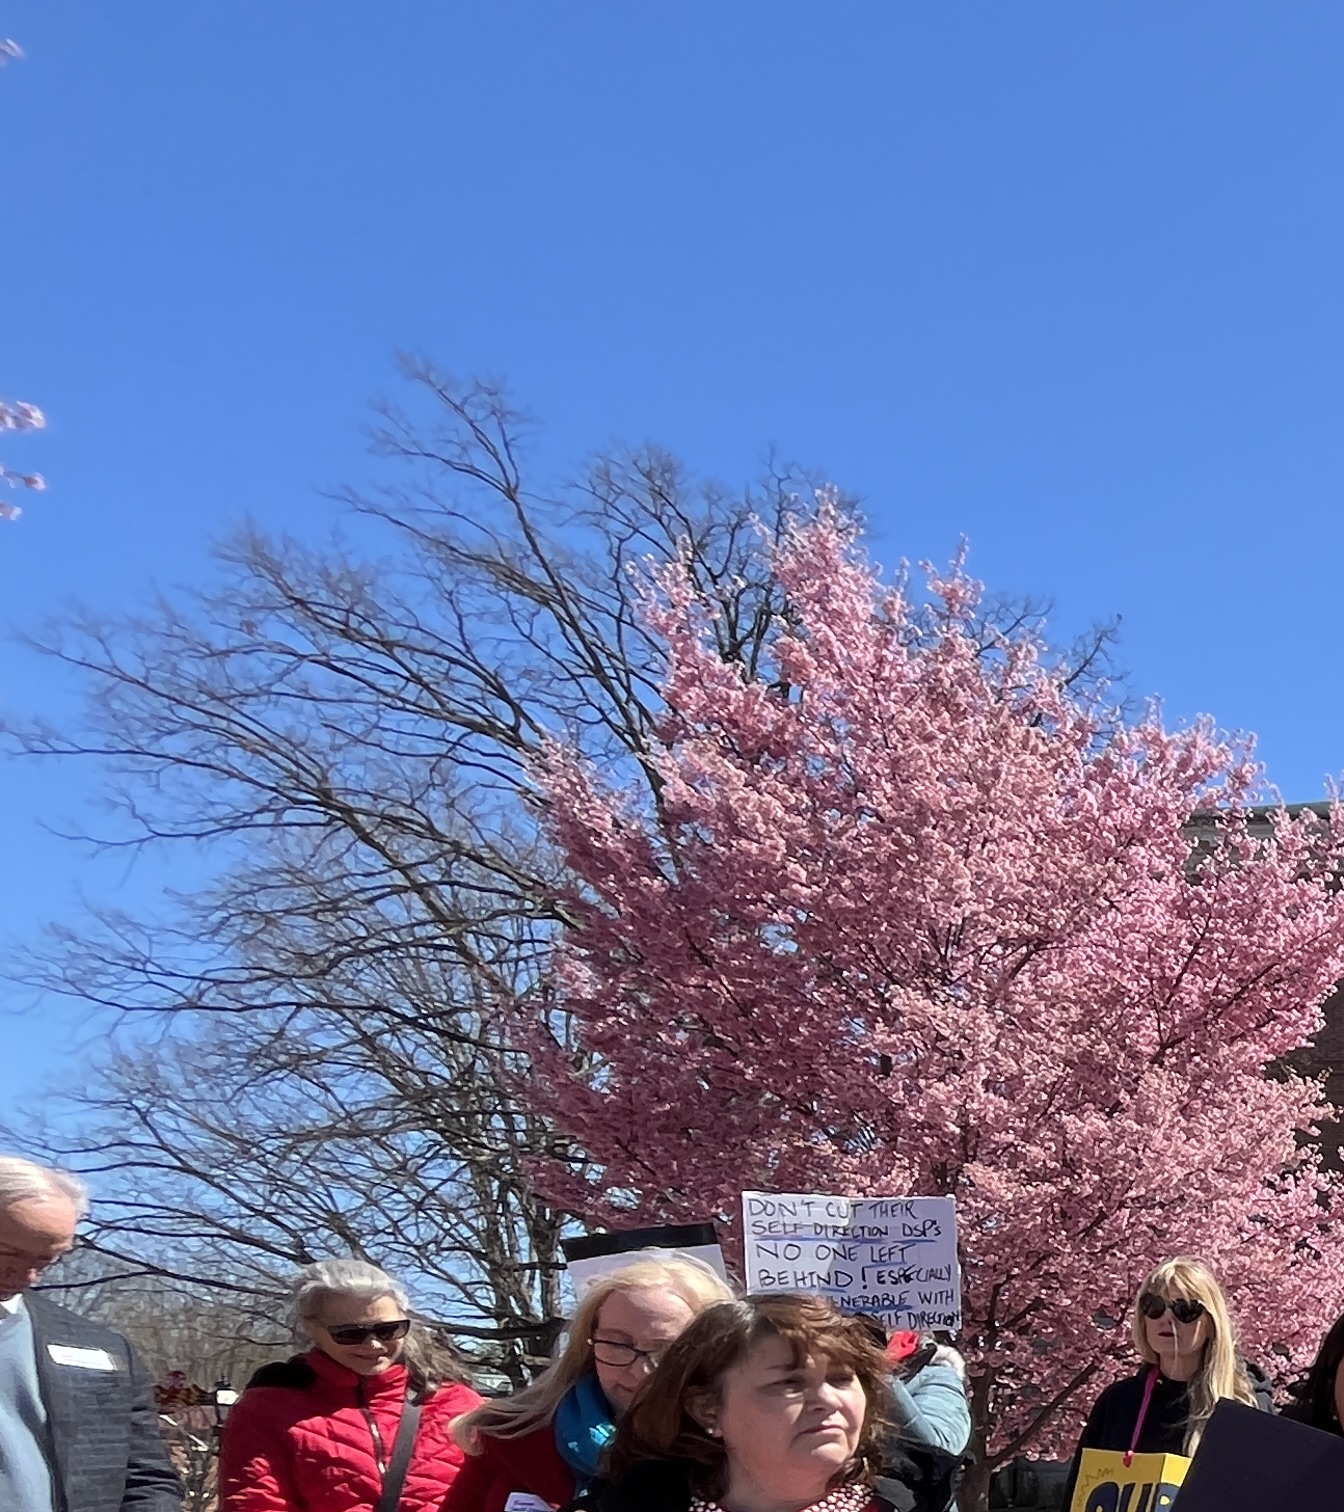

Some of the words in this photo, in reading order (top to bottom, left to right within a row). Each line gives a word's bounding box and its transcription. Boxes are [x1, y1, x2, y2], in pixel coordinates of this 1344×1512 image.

[750, 1200, 814, 1217] DON'T
[826, 1202, 863, 1218] CUT
[869, 1200, 918, 1219] THEIR
[751, 1220, 803, 1235] SELF
[756, 1243, 802, 1261] NO
[815, 1244, 859, 1261] ONE
[870, 1243, 917, 1263] LEFT
[877, 1264, 952, 1286] ESPECIALLY
[834, 1290, 910, 1307] NERABLE
[918, 1289, 955, 1306] WITH
